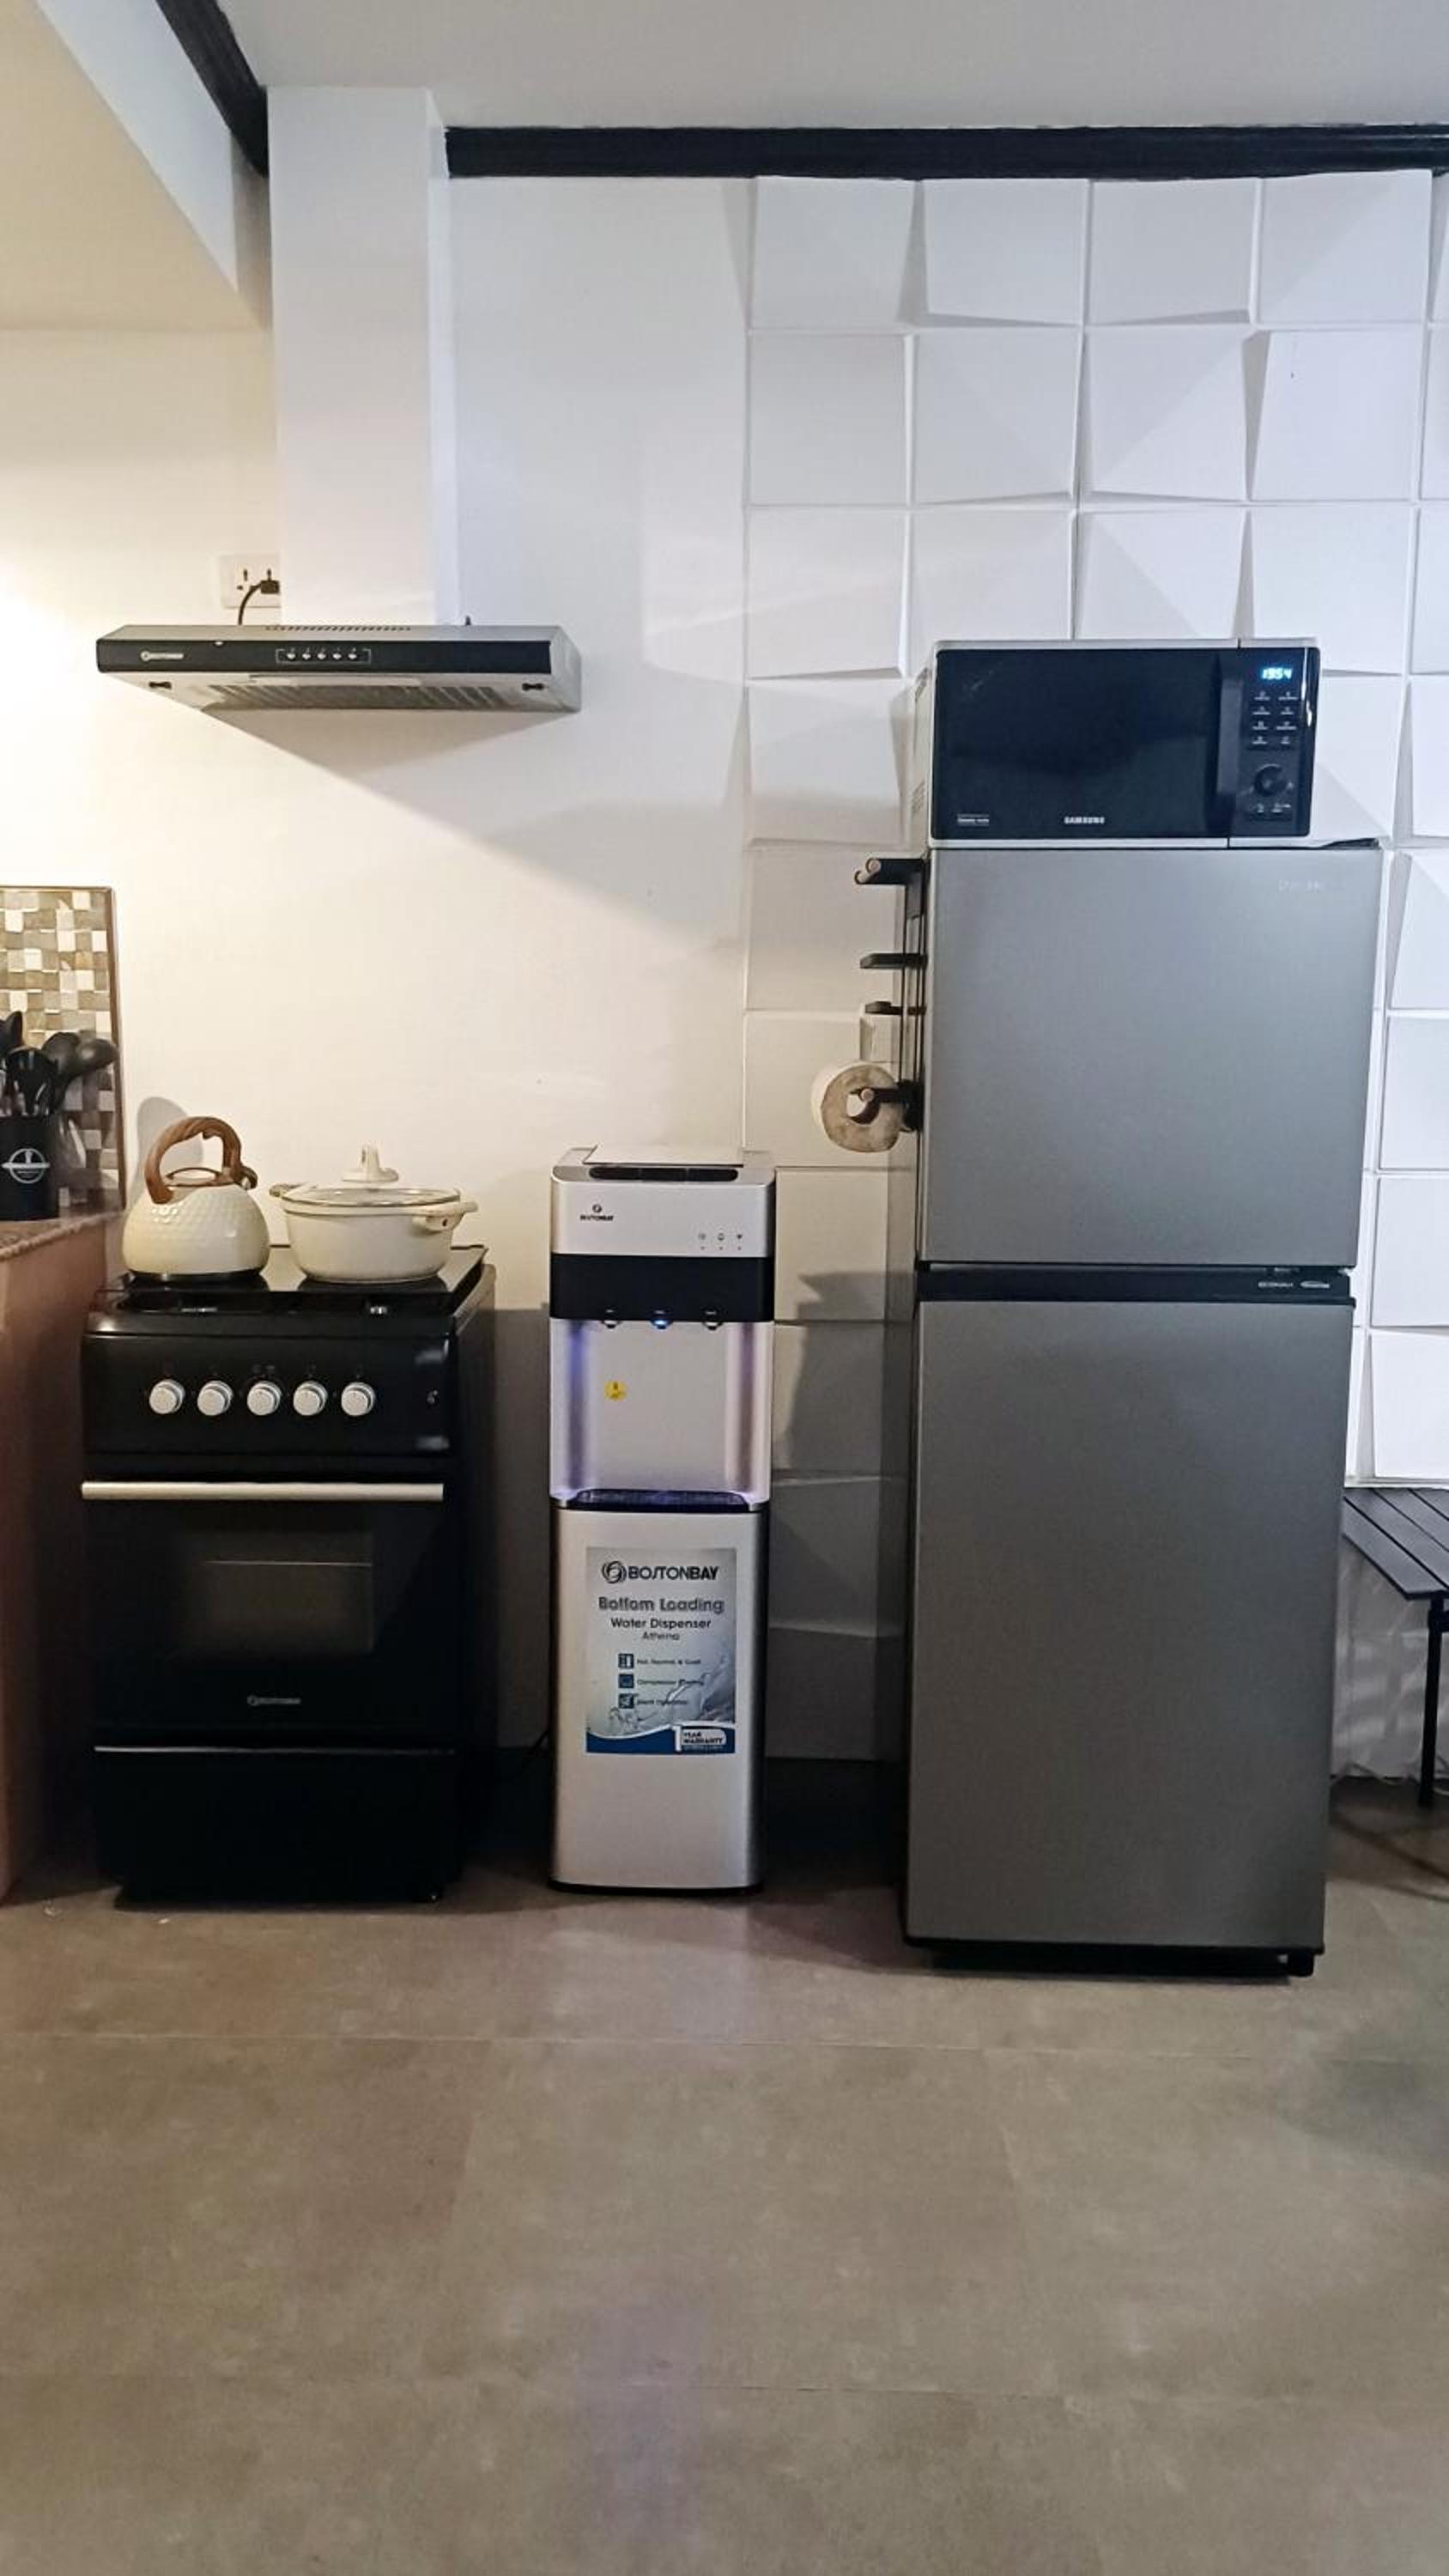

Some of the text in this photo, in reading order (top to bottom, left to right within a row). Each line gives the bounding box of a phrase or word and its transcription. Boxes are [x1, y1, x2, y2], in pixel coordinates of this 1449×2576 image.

[627, 1565, 719, 1580] BOSTONBAY
[598, 1596, 724, 1615] Bottom Loading
[610, 1618, 712, 1630] Water Dispenser
